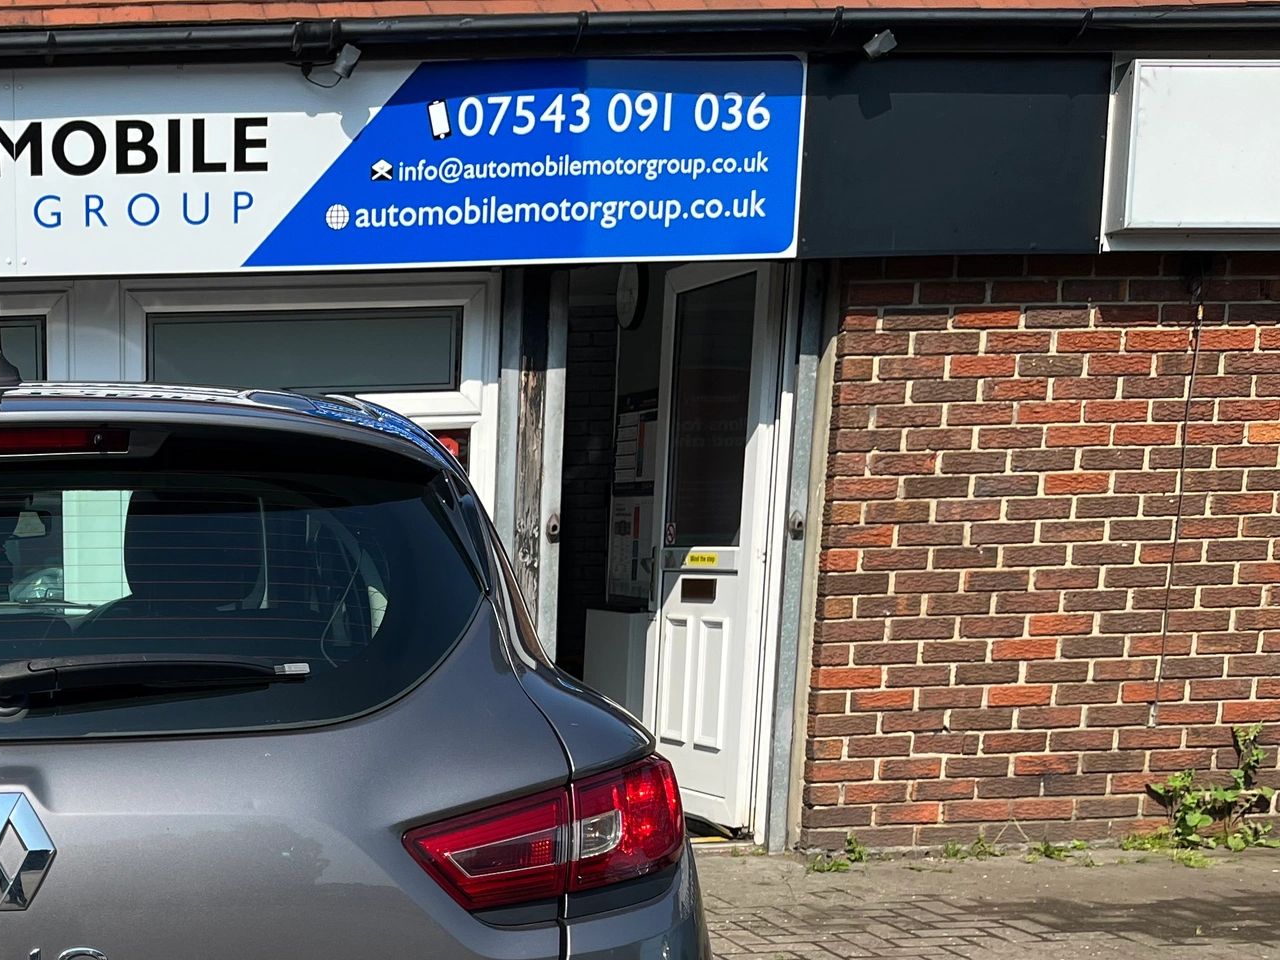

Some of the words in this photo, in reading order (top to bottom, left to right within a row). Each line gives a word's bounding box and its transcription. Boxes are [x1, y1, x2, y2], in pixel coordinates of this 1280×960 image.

[458, 93, 591, 138] 07543
[608, 91, 673, 133] 091
[694, 91, 771, 132] 036
[398, 151, 769, 184] info@automobilemotorgroup.co.uk
[33, 191, 254, 228] GROUP
[355, 190, 766, 232] automobilemotorgroup.co.uk
